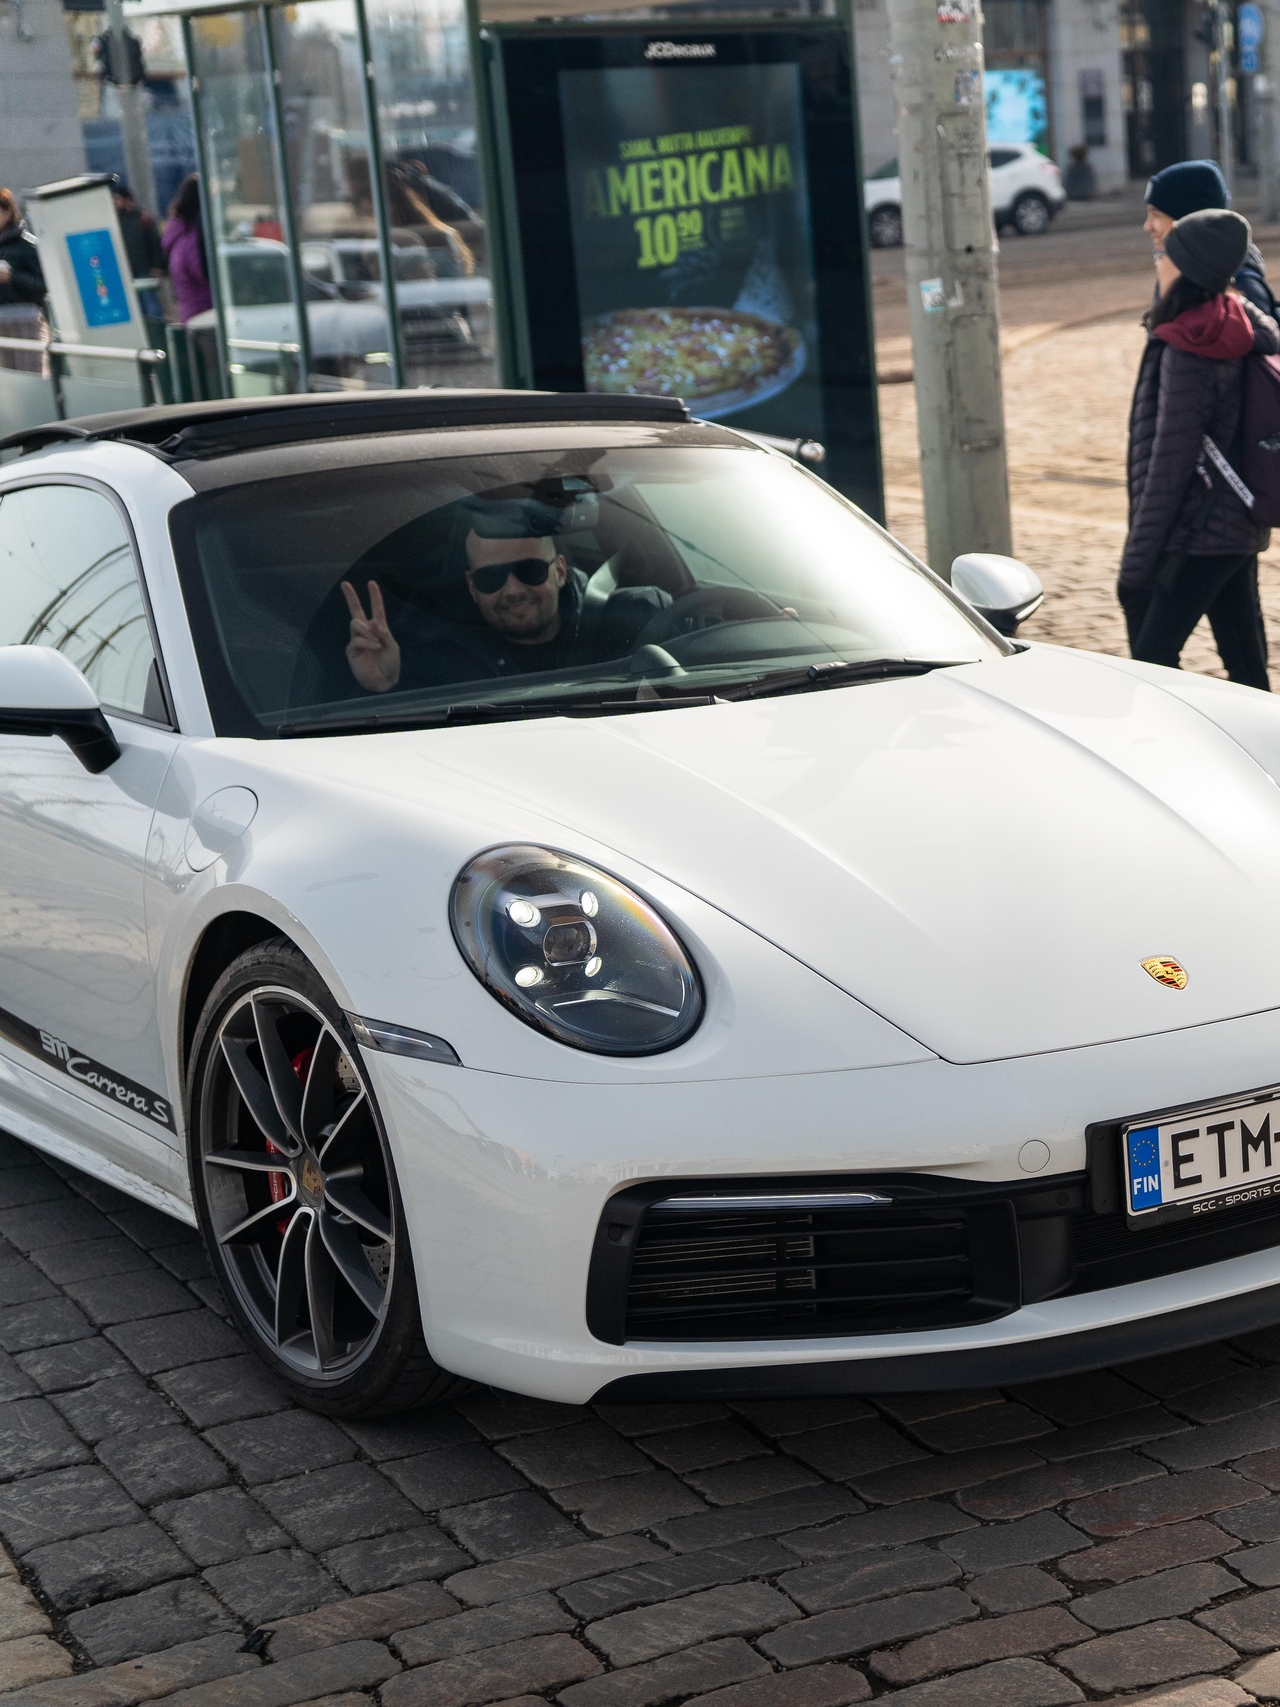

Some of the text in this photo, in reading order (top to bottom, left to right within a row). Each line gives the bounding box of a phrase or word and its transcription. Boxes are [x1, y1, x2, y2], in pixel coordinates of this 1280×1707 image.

[644, 41, 717, 59] JCDecaux
[585, 143, 793, 219] AMERICANA
[67, 1057, 149, 1112] Carrera
[150, 1100, 169, 1123] S
[1133, 1174, 1160, 1195] FIN
[1192, 1199, 1216, 1214] SCC
[1225, 1186, 1271, 1206] SPORTS
